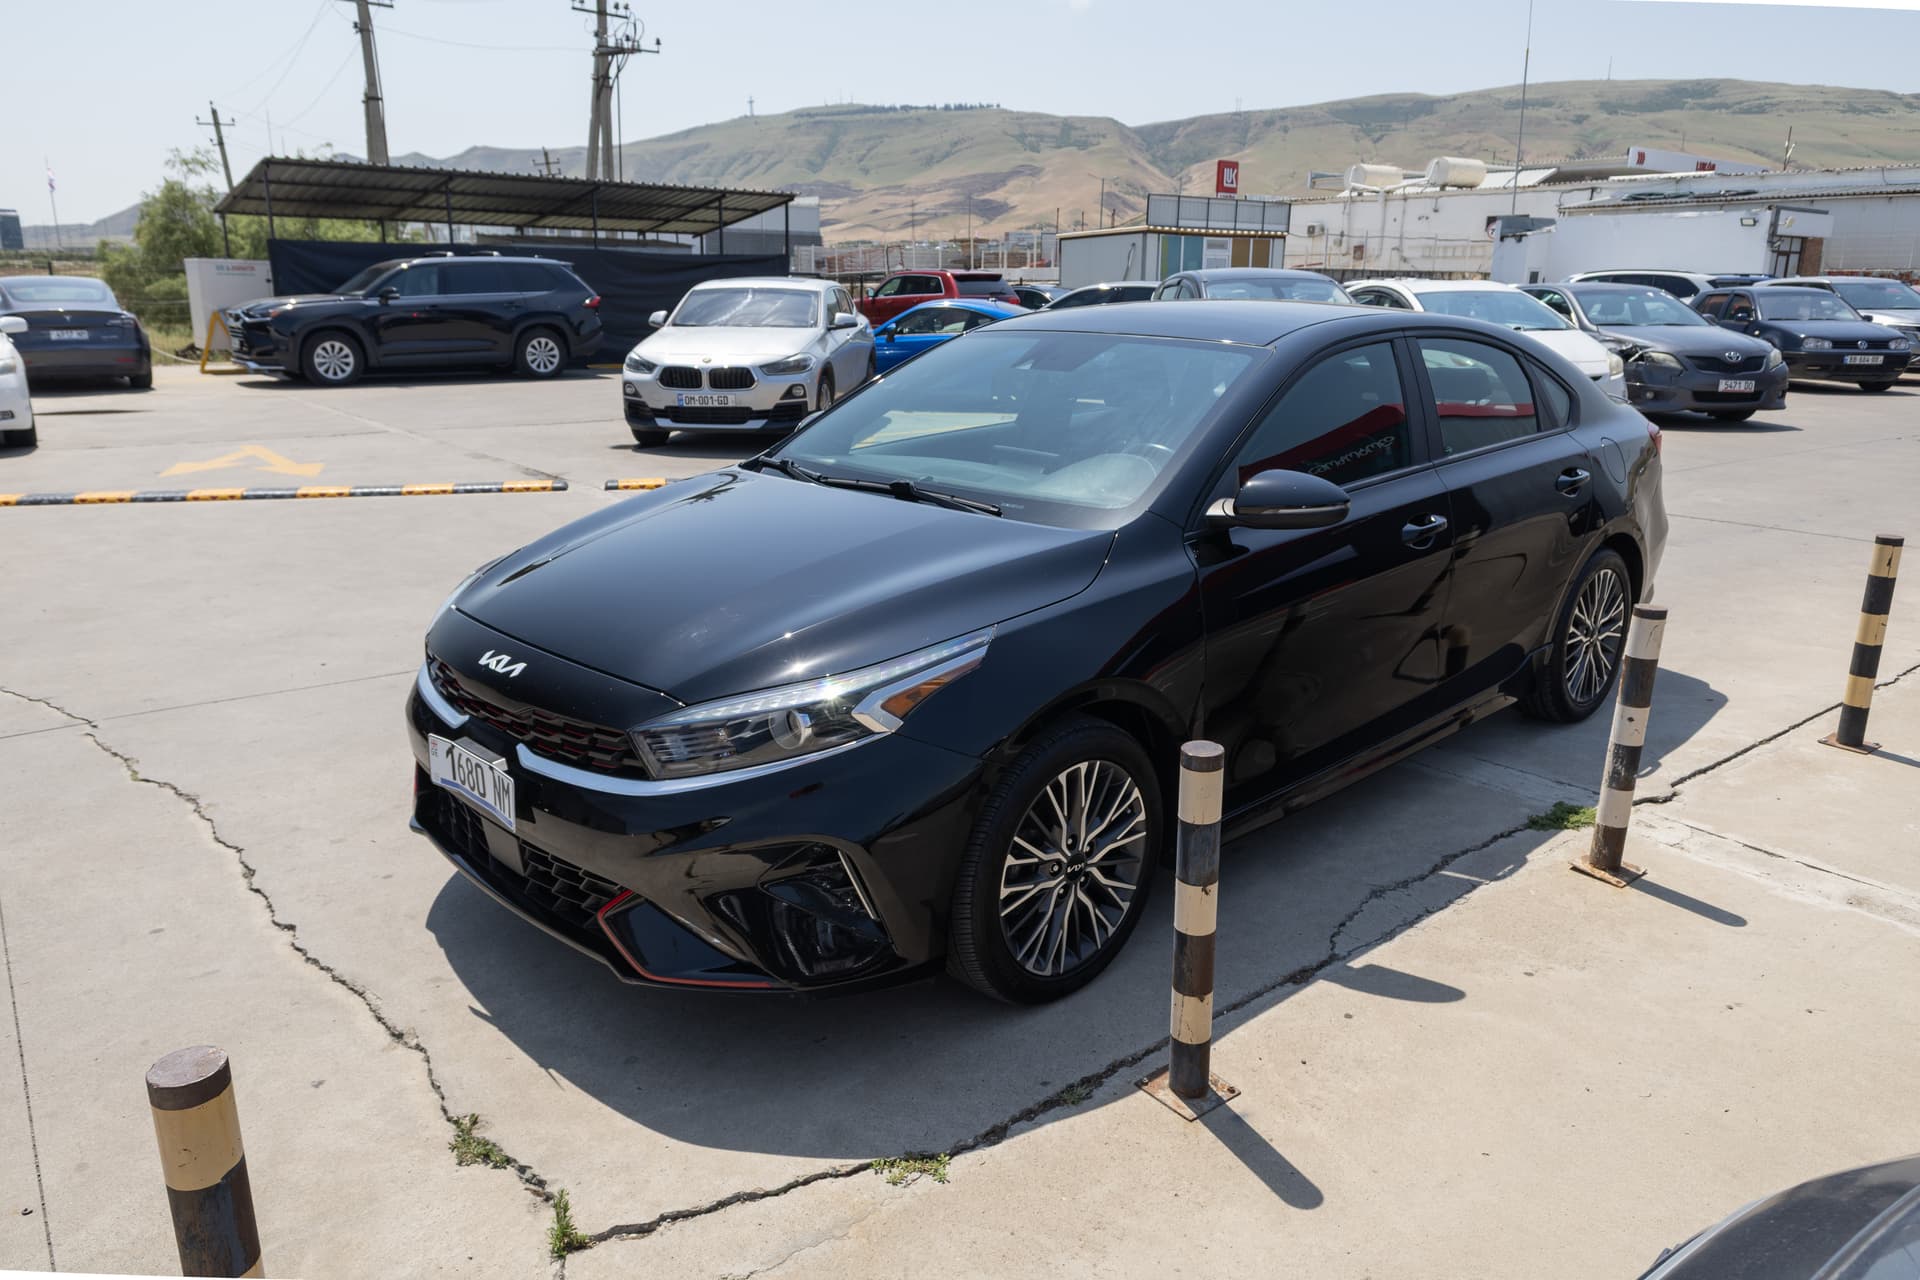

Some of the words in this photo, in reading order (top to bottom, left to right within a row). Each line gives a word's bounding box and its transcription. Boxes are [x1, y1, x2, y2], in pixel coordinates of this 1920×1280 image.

[478, 650, 527, 678] KIA
[446, 745, 486, 799] 1680
[489, 765, 511, 819] NM
